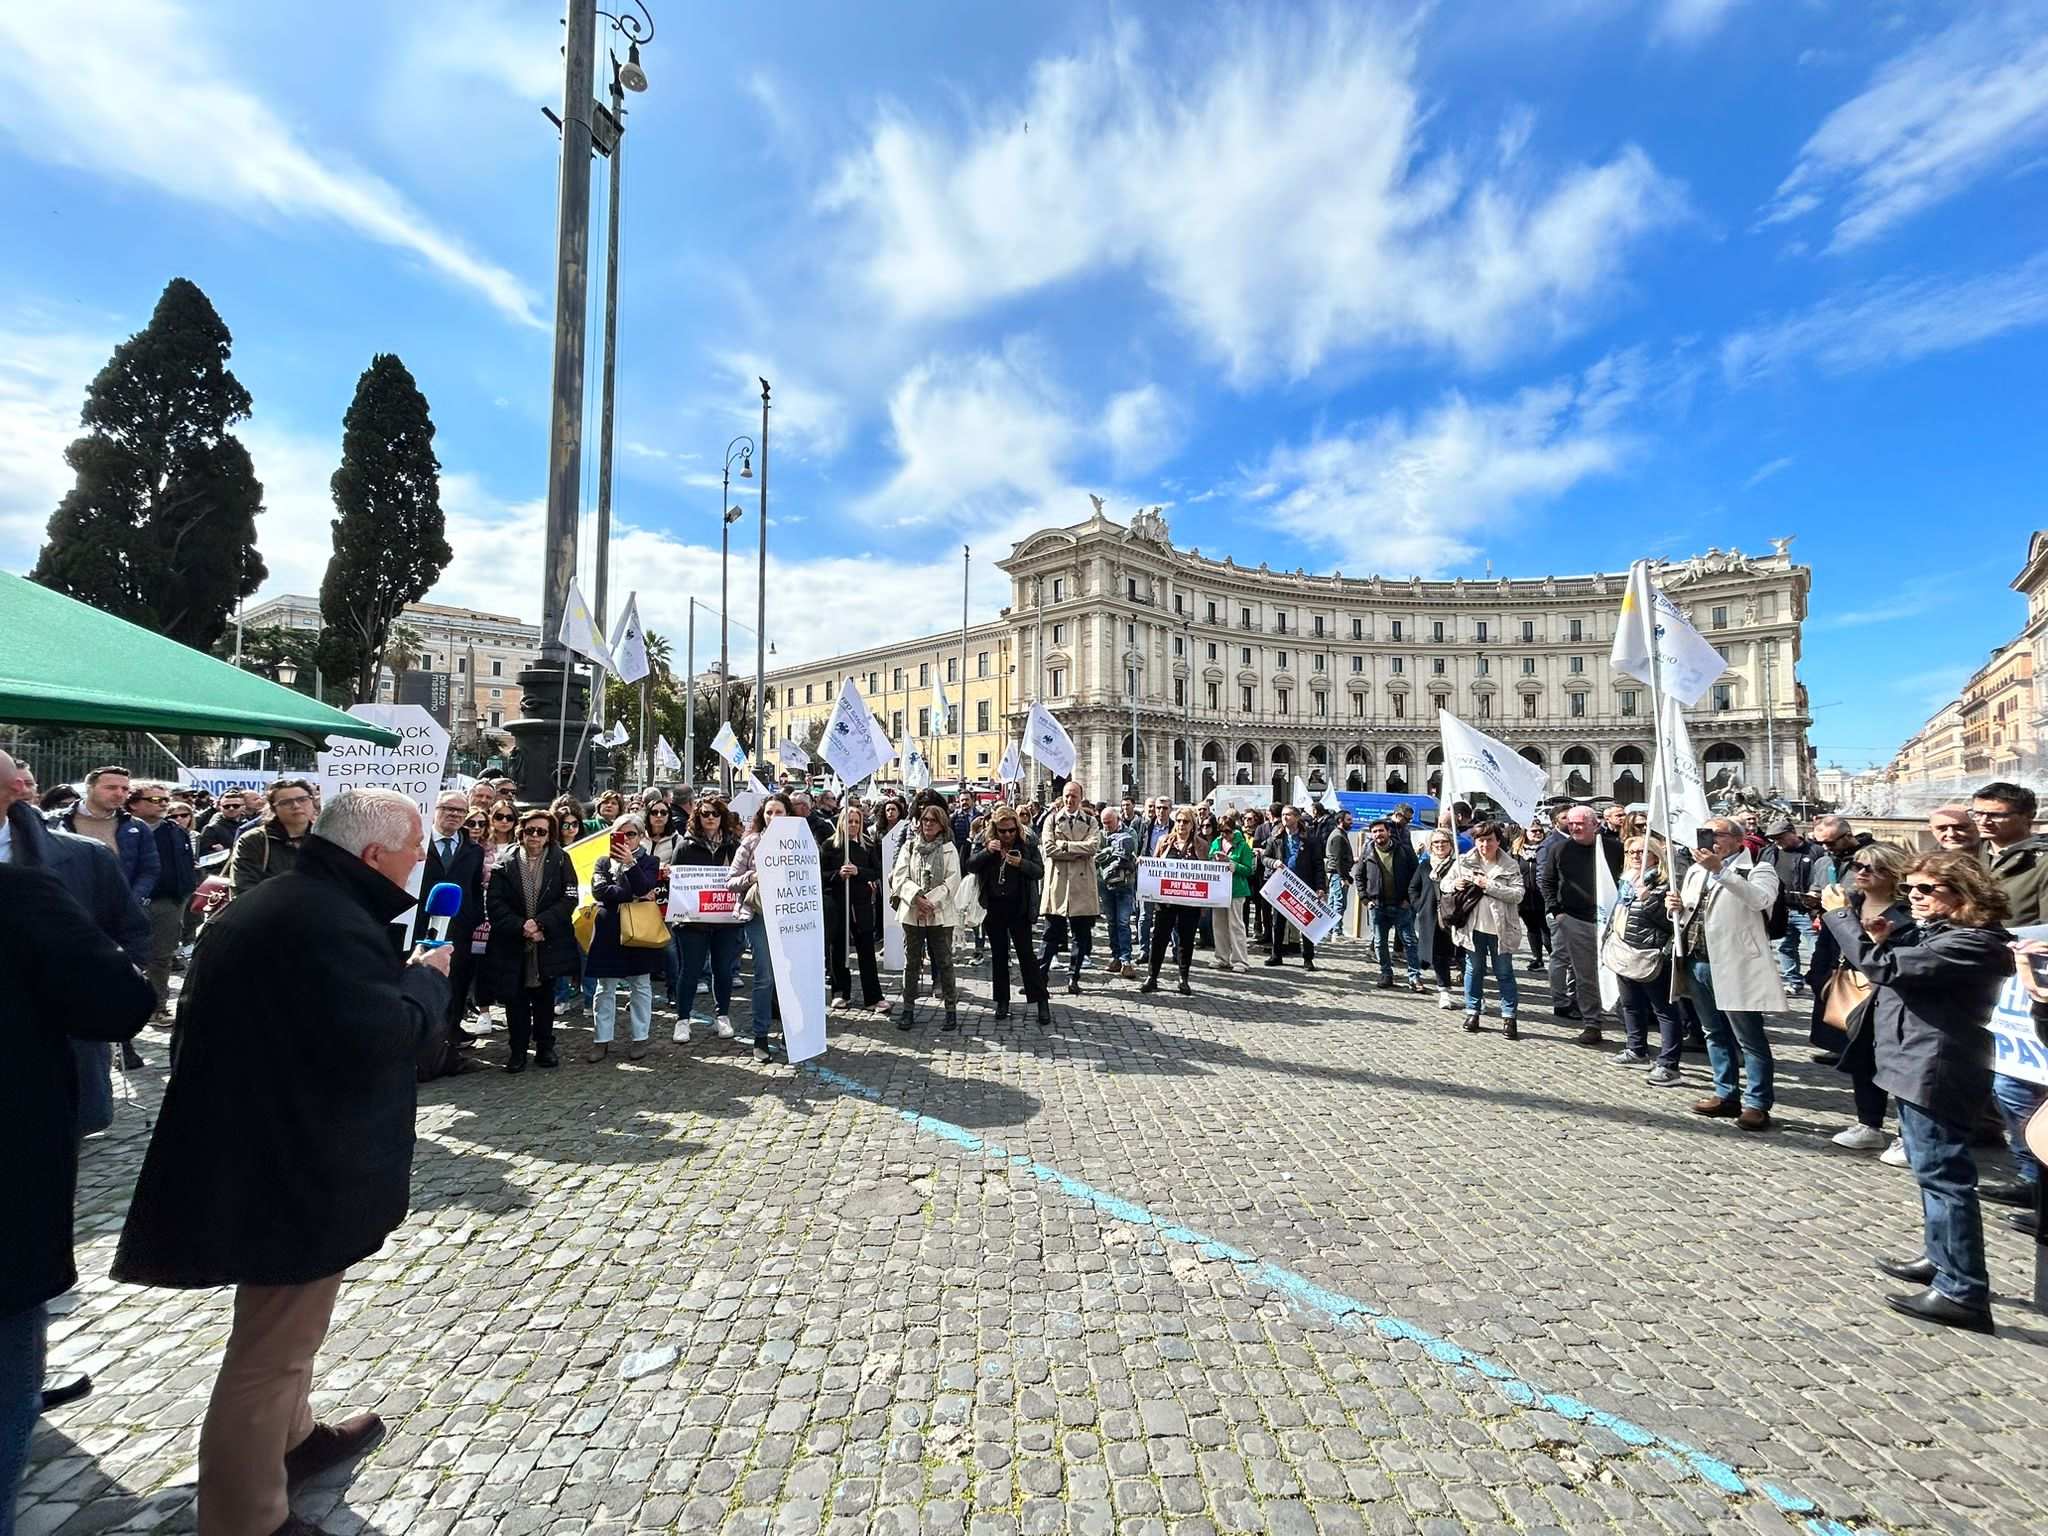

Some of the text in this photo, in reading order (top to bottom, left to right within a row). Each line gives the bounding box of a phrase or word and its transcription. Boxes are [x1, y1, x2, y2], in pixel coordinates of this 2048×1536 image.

[328, 762, 440, 777] ESPROPRIO
[779, 839, 801, 850] NON
[764, 854, 818, 867] CURERANNO
[1139, 859, 1167, 869] PAYBACK
[1175, 862, 1190, 870] FINE
[1190, 863, 1202, 871] DEL
[1148, 869, 1221, 882] ALLE CURE OSPEDALIERE
[1170, 881, 1197, 890] PAY BACK
[712, 892, 726, 903] PAY
[777, 887, 794, 899] MA
[795, 886, 807, 897] VE
[779, 925, 794, 935] PMI
